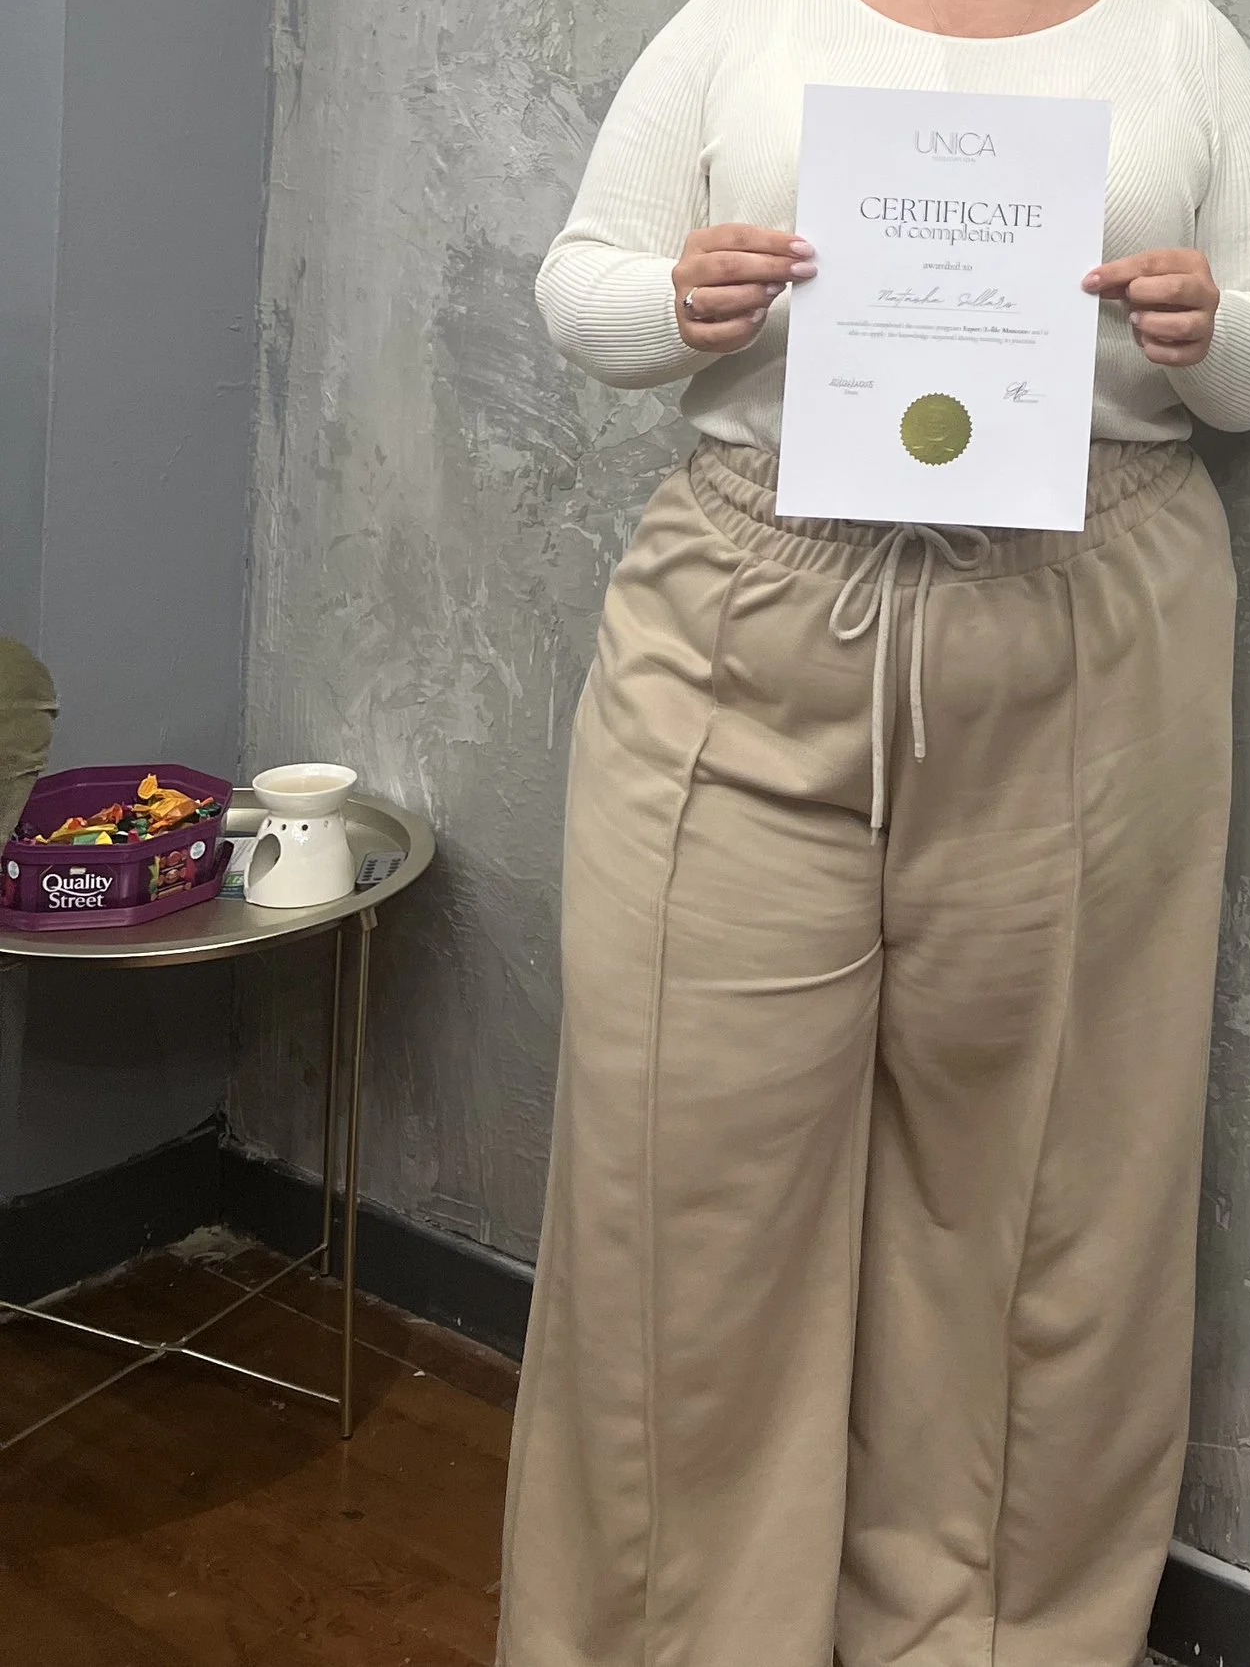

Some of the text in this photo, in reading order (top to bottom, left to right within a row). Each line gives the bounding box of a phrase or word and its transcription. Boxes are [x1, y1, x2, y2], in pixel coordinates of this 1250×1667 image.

[914, 130, 996, 157] UNICA
[860, 197, 1042, 228] CERTIFICATE
[885, 221, 1014, 246] of completion
[923, 261, 960, 271] awarded
[42, 873, 113, 896] Quality
[49, 893, 105, 909] Street
